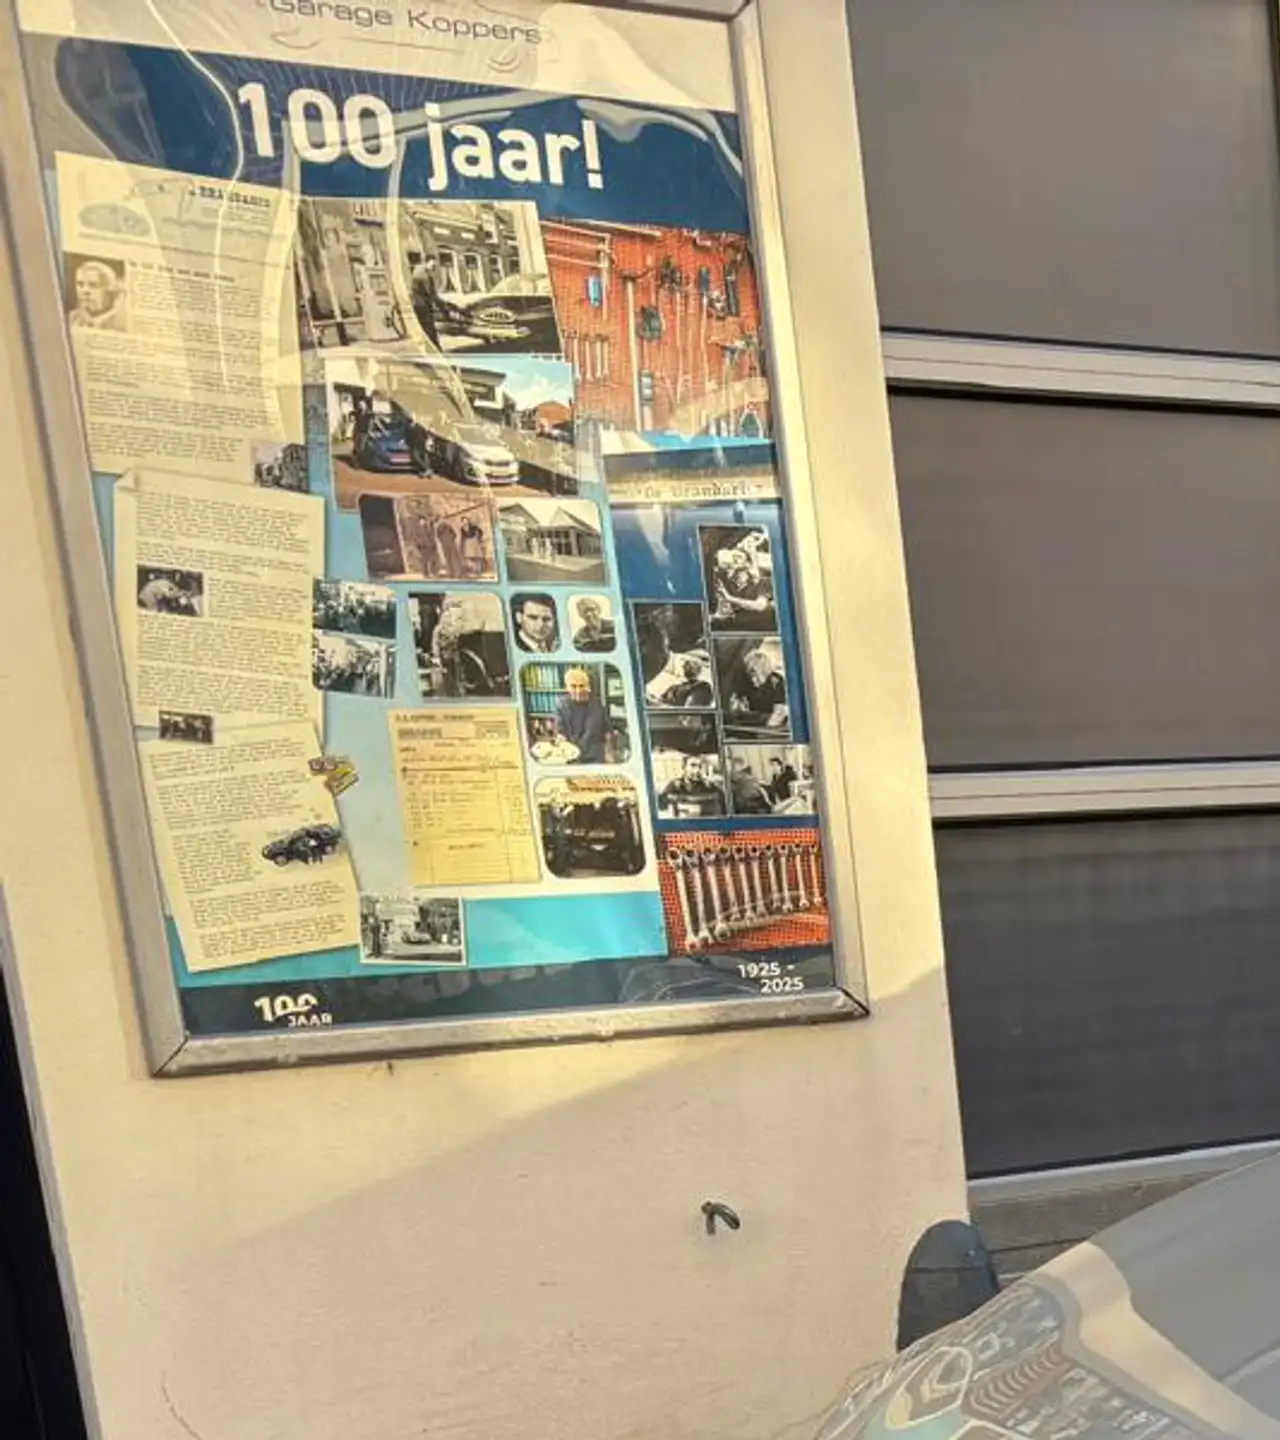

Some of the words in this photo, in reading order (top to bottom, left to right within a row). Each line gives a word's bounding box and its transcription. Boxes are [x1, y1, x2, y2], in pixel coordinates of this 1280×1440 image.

[270, 0, 393, 27] Garage
[406, 8, 542, 45] Koppers
[238, 82, 396, 170] 100
[425, 102, 604, 192] jaar!
[737, 962, 780, 978] 1925
[760, 976, 805, 994] 2025
[287, 1012, 333, 1029] JAAR
